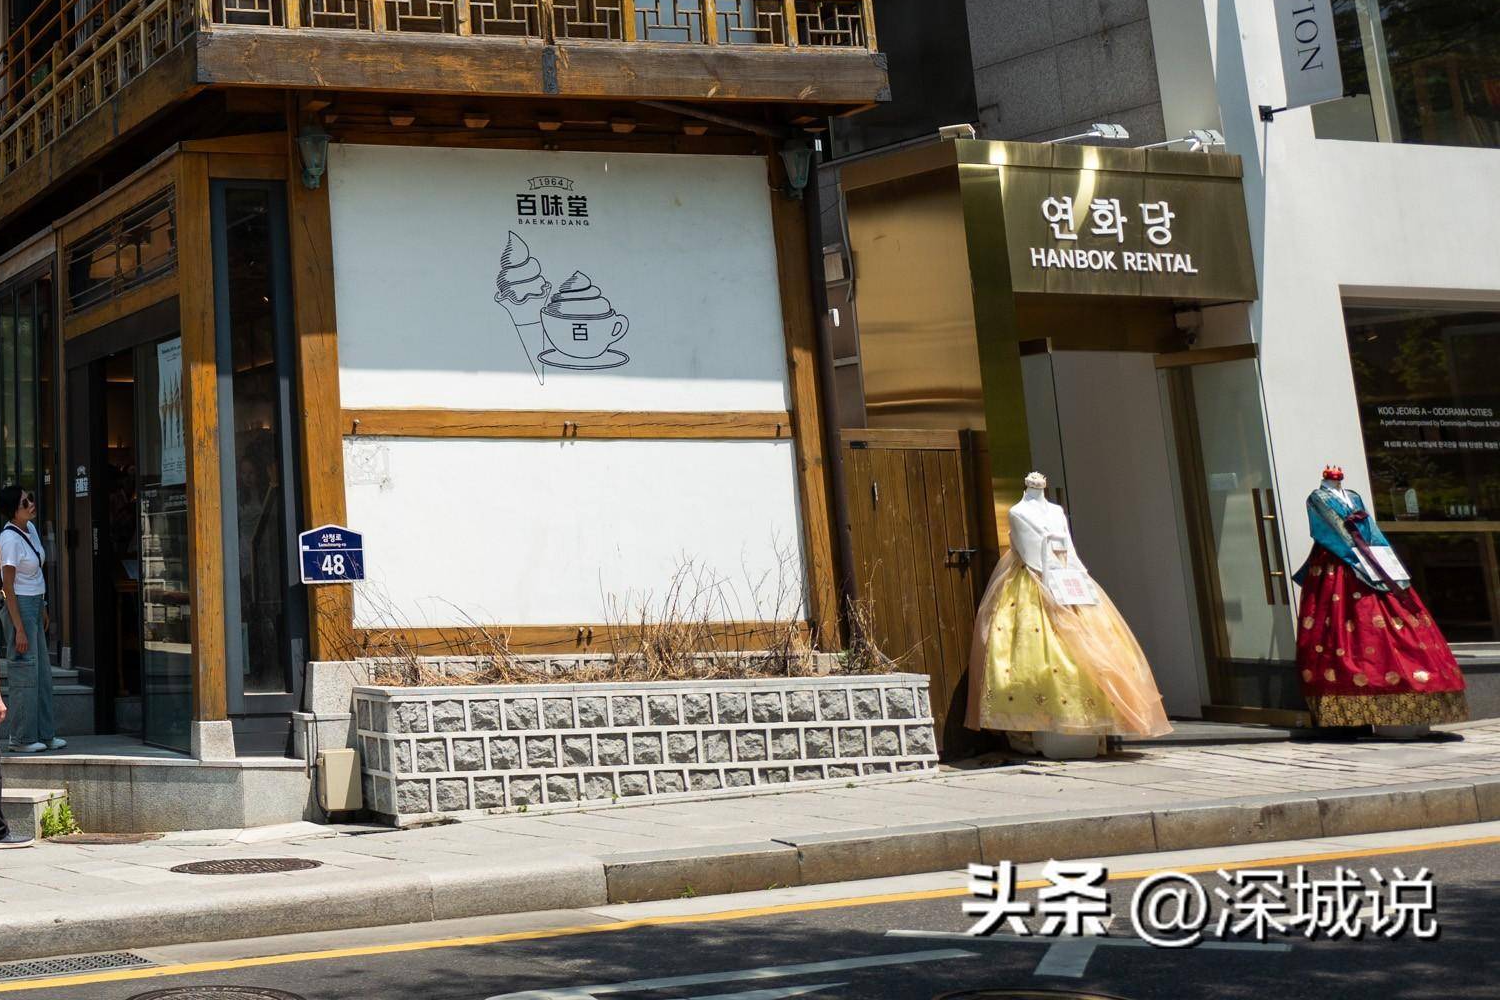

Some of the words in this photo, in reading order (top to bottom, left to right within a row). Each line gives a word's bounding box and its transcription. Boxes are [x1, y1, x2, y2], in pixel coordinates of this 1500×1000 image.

[538, 177, 564, 186] 1964
[516, 193, 589, 217] 百味堂
[518, 218, 590, 226] BAEKMIDANG
[1041, 195, 1176, 246] 연화당
[1029, 247, 1118, 271] HANBOK
[1122, 251, 1199, 274] RENTAL
[572, 323, 588, 341] 百
[1378, 407, 1394, 416] KOO
[1395, 407, 1421, 416] JEONG
[1432, 407, 1470, 417] ODORAMA
[321, 533, 343, 543] 삼청로
[321, 554, 345, 576] 48
